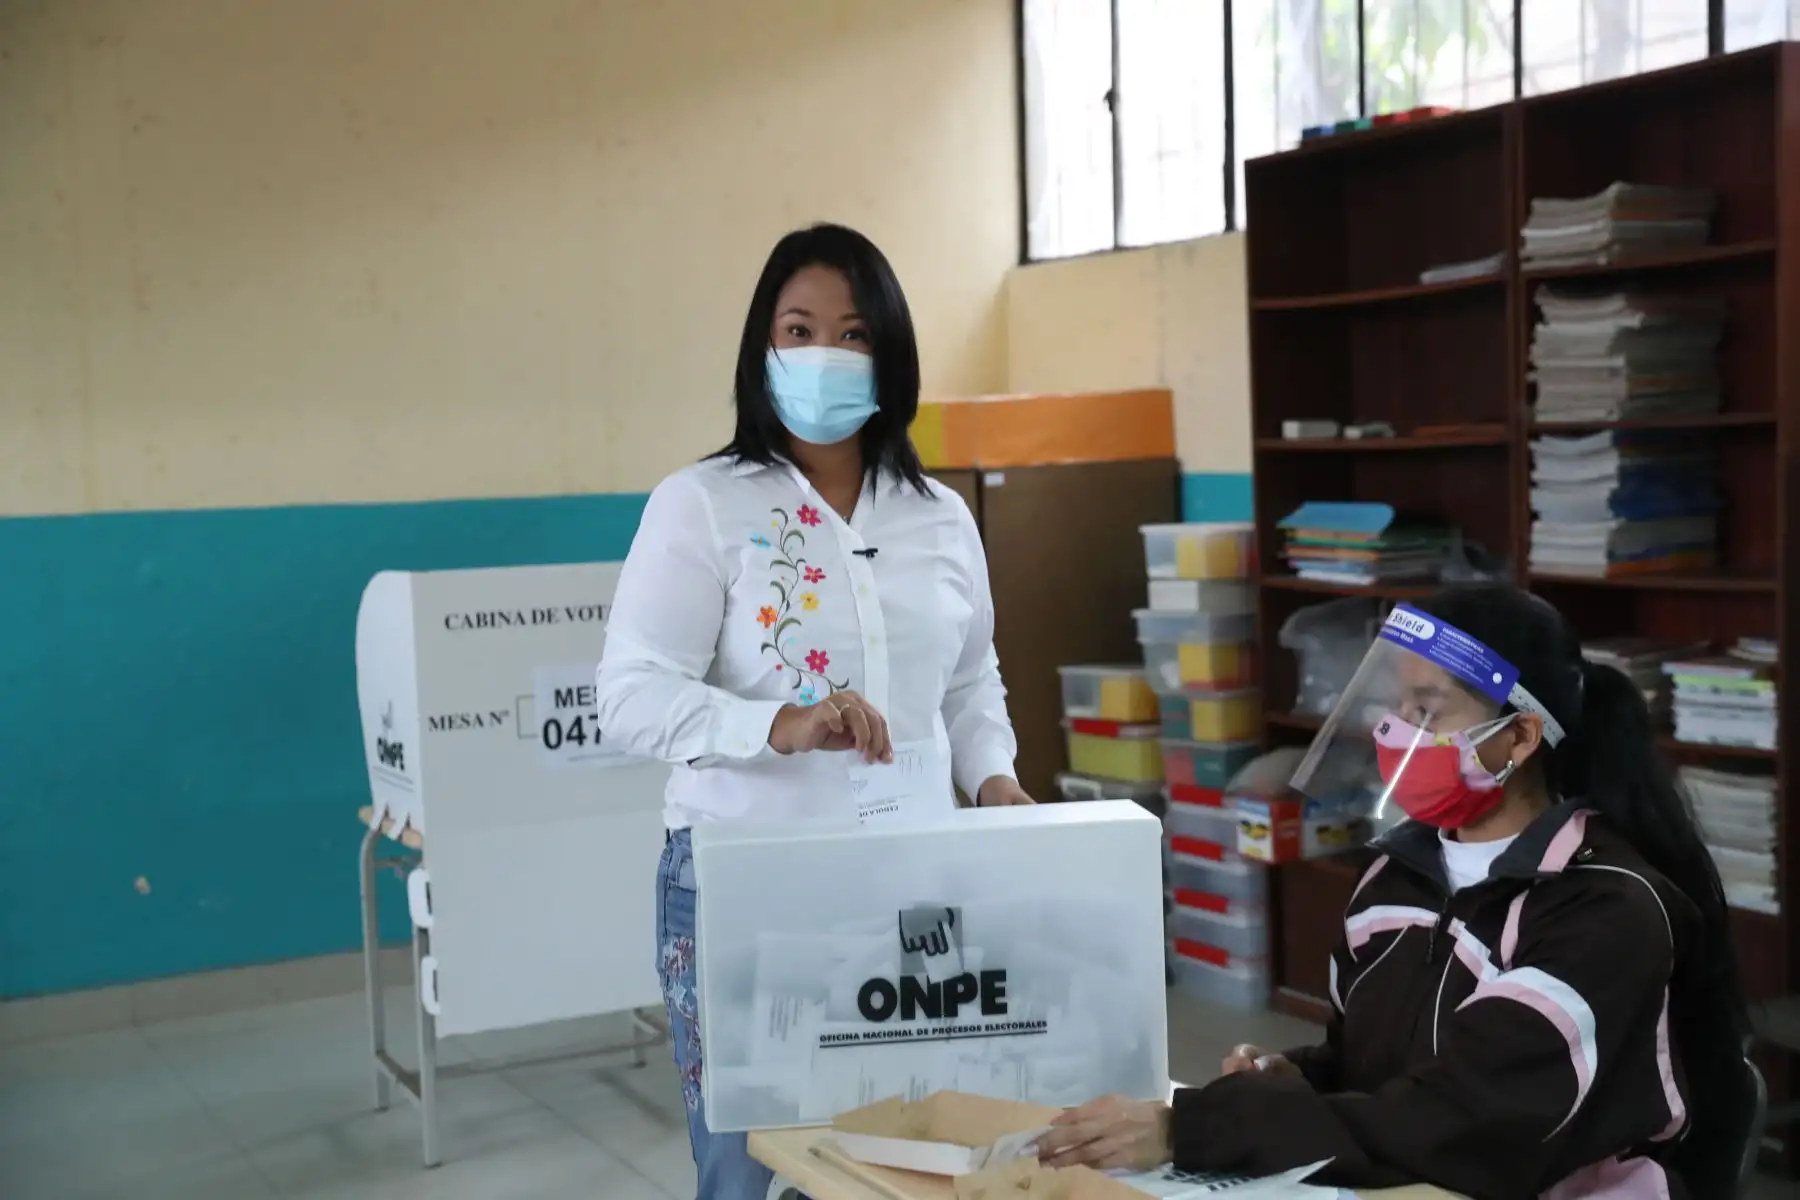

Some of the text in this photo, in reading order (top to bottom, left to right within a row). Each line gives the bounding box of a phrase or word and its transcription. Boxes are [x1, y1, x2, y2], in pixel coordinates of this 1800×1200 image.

[444, 603, 612, 630] CABINA DE VOT
[554, 684, 598, 710] ME
[428, 711, 484, 732] MESA
[857, 968, 1008, 1023] ONPE
[819, 1019, 1048, 1042] OFICINA NACIONAL DE PROCESOS ELECTORALES
